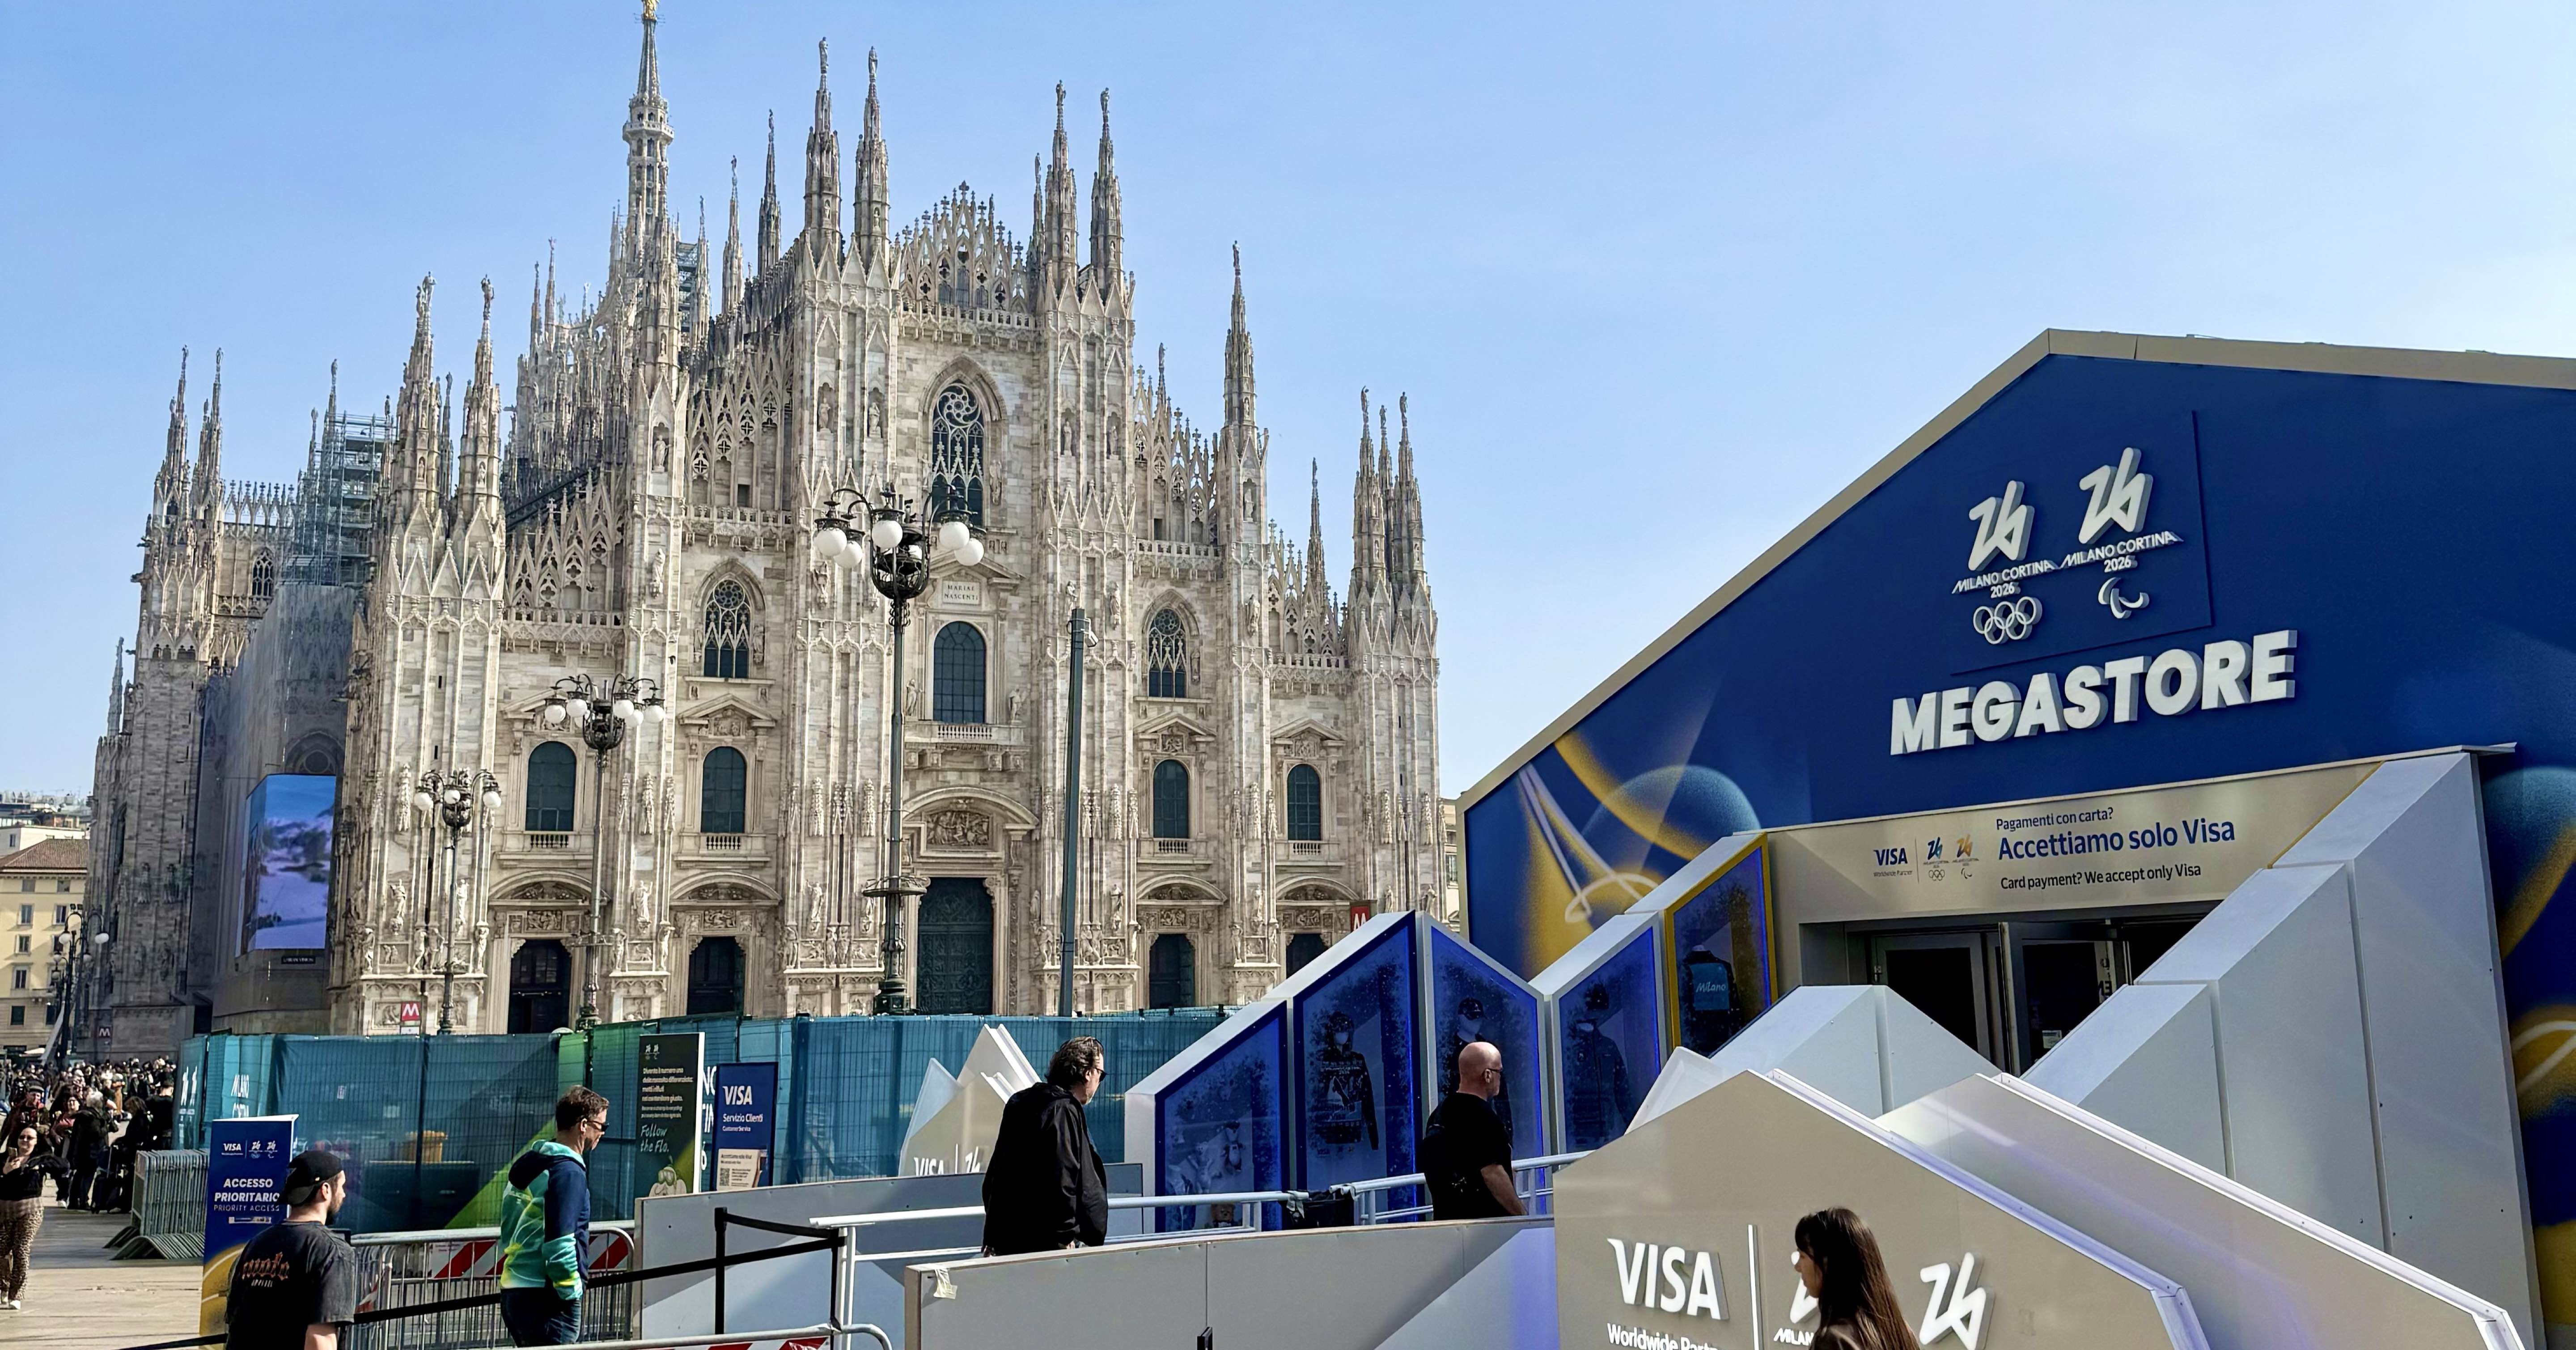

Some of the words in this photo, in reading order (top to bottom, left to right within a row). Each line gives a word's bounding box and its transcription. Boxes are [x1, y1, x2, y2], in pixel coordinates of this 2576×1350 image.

[2060, 544, 2114, 569] MILANO
[2117, 531, 2178, 555] CORTINA
[2104, 555, 2132, 573] 2026
[1952, 572, 1999, 594] MILANO
[2002, 560, 2055, 581] CORTINA
[1991, 582, 2015, 599] 2026
[1890, 630, 2297, 756] MEGASTORE
[1996, 813, 2054, 832] Pagamenti
[2056, 815, 2077, 824] con
[2079, 807, 2114, 822] carta?
[1998, 831, 2124, 860] Accettiamo
[2129, 822, 2178, 849] solo
[2182, 818, 2235, 845] Visa
[1873, 848, 1908, 866] VISA
[2001, 875, 2025, 889] Card
[2027, 871, 2082, 890] payment?
[2084, 871, 2104, 884] We
[2106, 867, 2145, 883] accept
[2147, 865, 2173, 881] only
[2175, 864, 2201, 877] Visa
[402, 1003, 419, 1016] M
[99, 1028, 110, 1036] M
[722, 1086, 752, 1105] VISA
[723, 1113, 745, 1122] Servizio
[746, 1113, 763, 1122] Clienti
[640, 1124, 668, 1137] Follow
[640, 1139, 653, 1152] the
[223, 1178, 273, 1188] ACCESSO
[214, 1192, 280, 1202] PRIORITARIO
[1607, 1238, 1722, 1320] VISA
[1607, 1323, 1679, 1350] Worldwide
[1773, 1327, 1814, 1346] MILAN
